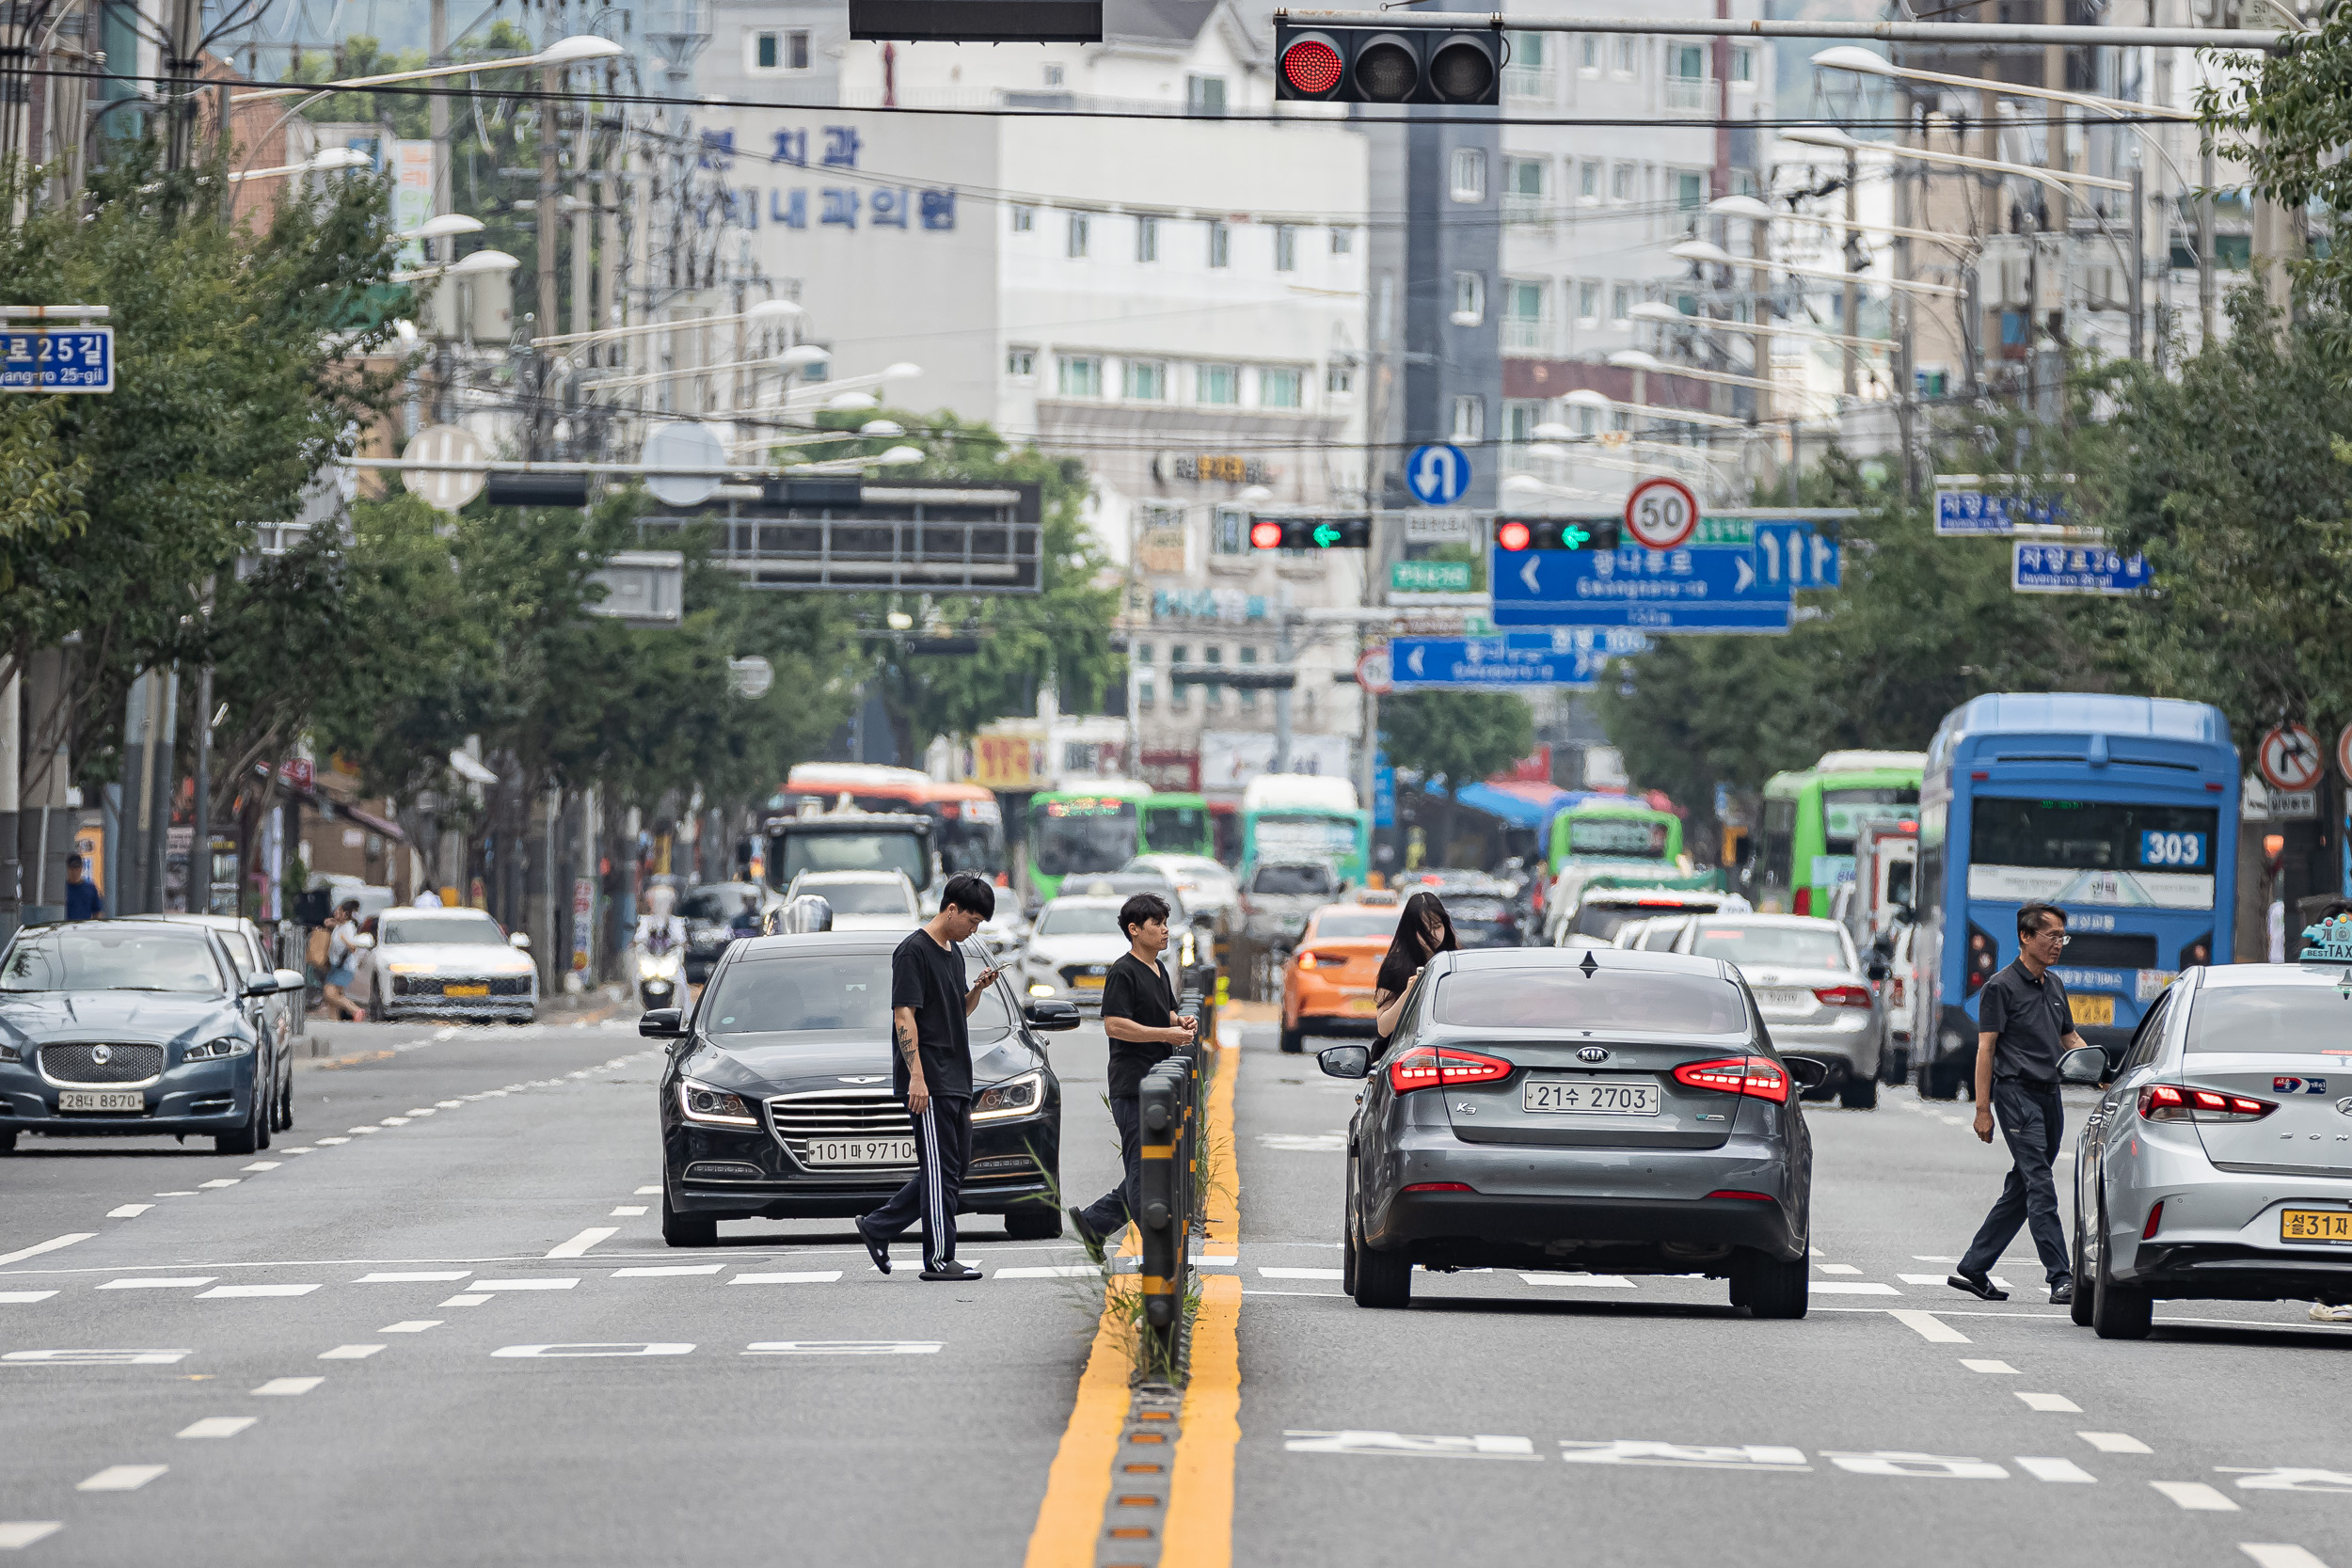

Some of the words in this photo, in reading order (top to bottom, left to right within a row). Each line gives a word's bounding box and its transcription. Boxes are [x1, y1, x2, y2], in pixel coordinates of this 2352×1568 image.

[0, 335, 103, 366] 로25길
[60, 368, 103, 386] 25-gil
[1641, 497, 1683, 530] 50
[2147, 832, 2199, 864] 303
[2321, 928, 2332, 941] 개
[1581, 1050, 1608, 1061] KIA
[2277, 1079, 2292, 1089] 서울
[100, 1094, 135, 1108] 8870
[1537, 1086, 1581, 1107] 21수
[1591, 1087, 1646, 1108] 2703
[1456, 1102, 1477, 1116] K3
[816, 1143, 862, 1161] 101마
[866, 1142, 912, 1160] 9710
